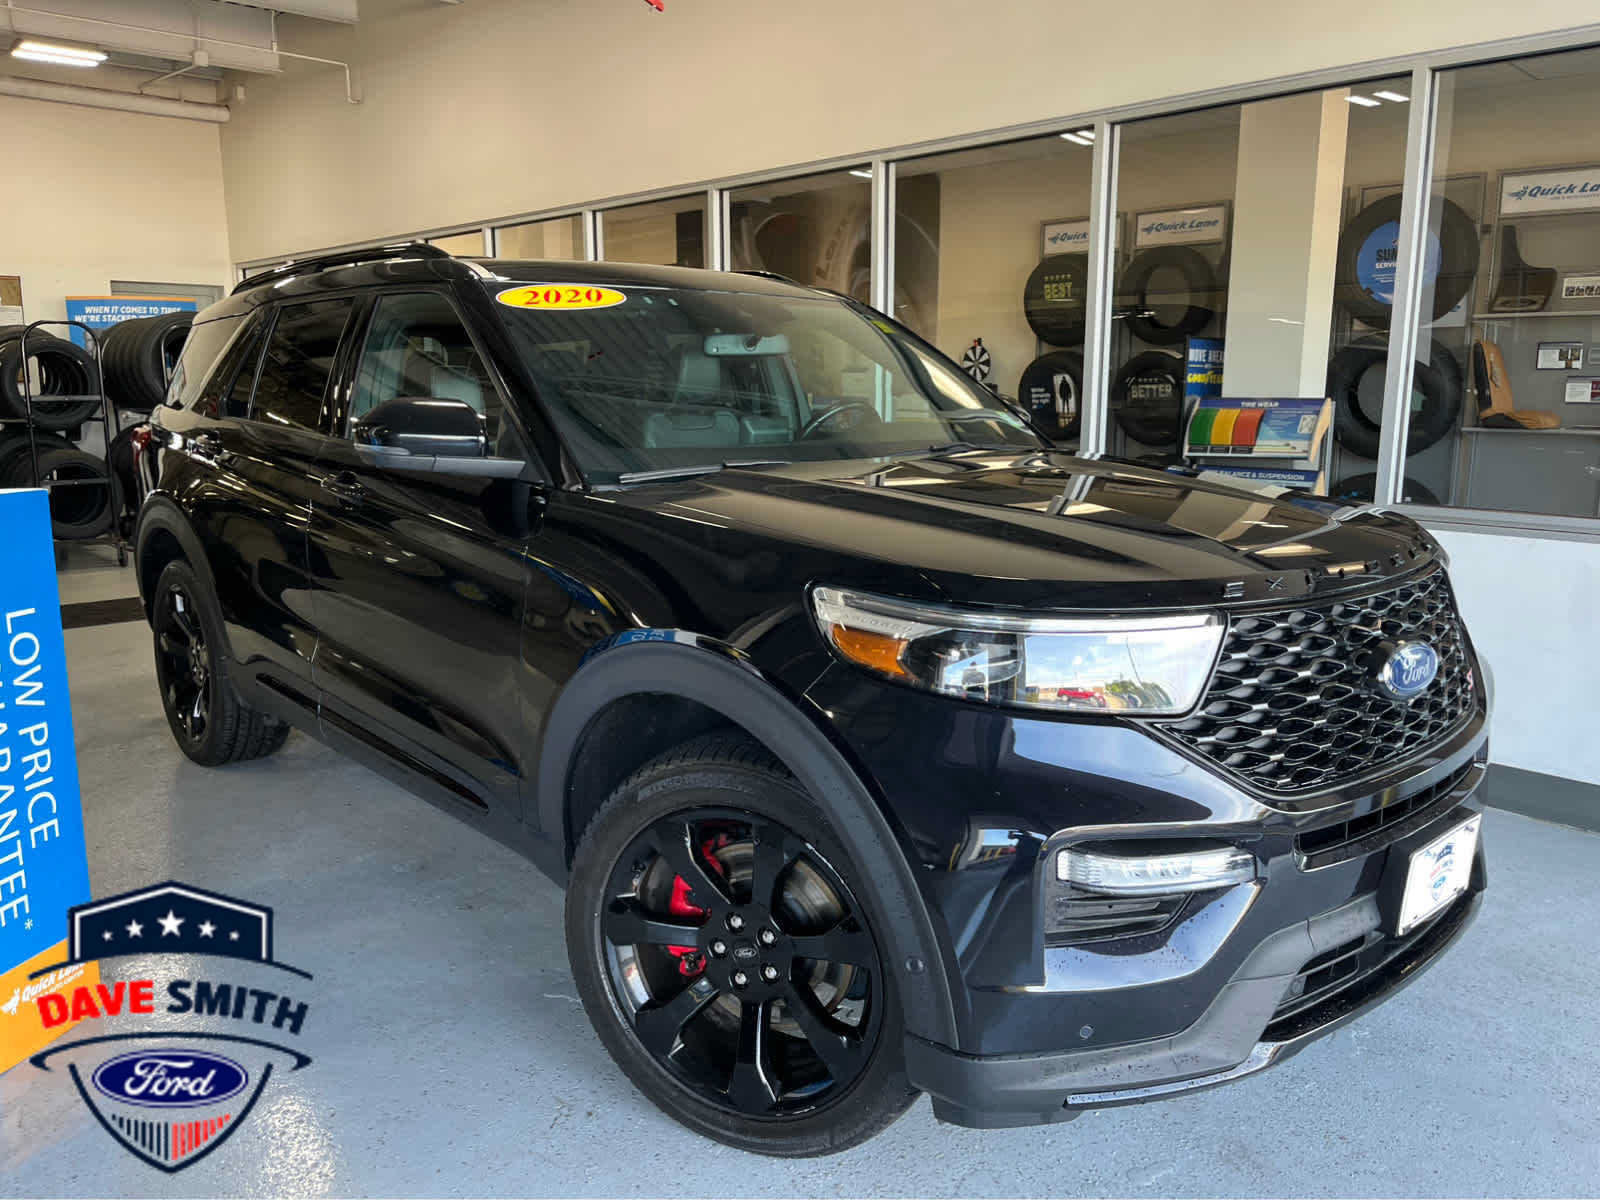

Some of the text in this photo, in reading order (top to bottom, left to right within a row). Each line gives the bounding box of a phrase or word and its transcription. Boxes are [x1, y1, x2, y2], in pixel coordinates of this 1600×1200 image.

[1527, 183, 1577, 198] Quick
[1155, 221, 1187, 232] Quick
[523, 288, 603, 305] 2020
[1043, 281, 1073, 299] BEST
[84, 305, 110, 314] WHEN
[111, 306, 119, 314] IT
[120, 306, 146, 315] COMES
[149, 306, 159, 315] TO
[75, 314, 100, 323] WE'RE
[1131, 384, 1172, 399] BETTER
[1258, 472, 1305, 481] SUSPENSION
[6, 607, 60, 849] LOW PRICE
